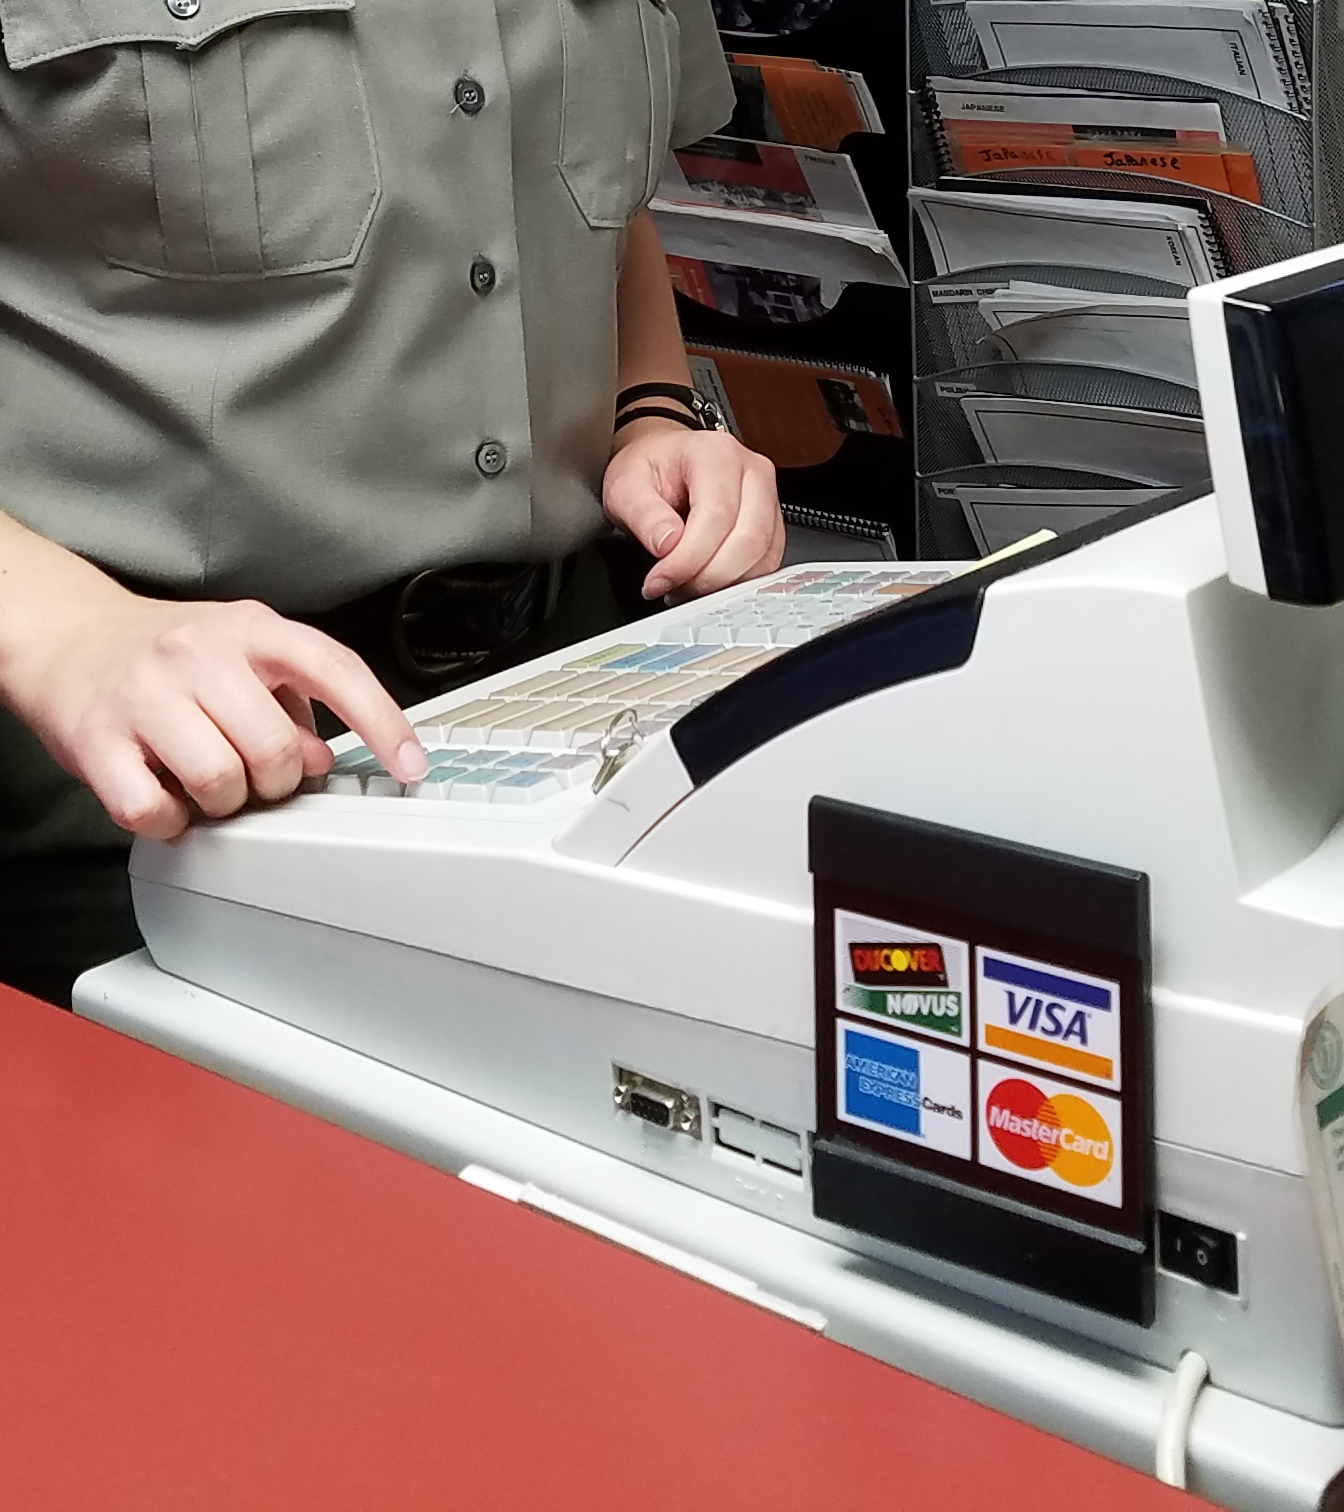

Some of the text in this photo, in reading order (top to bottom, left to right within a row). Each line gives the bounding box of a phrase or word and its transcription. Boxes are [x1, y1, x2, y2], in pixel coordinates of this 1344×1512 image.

[1229, 42, 1247, 76] ITALIAN
[1165, 235, 1182, 267] KOREAN
[852, 947, 944, 973] DISCOVER
[885, 992, 960, 1018] NOVUS
[1003, 989, 1089, 1048] VISA
[921, 1096, 964, 1121] Cards
[988, 1104, 1110, 1162] MasterCard
